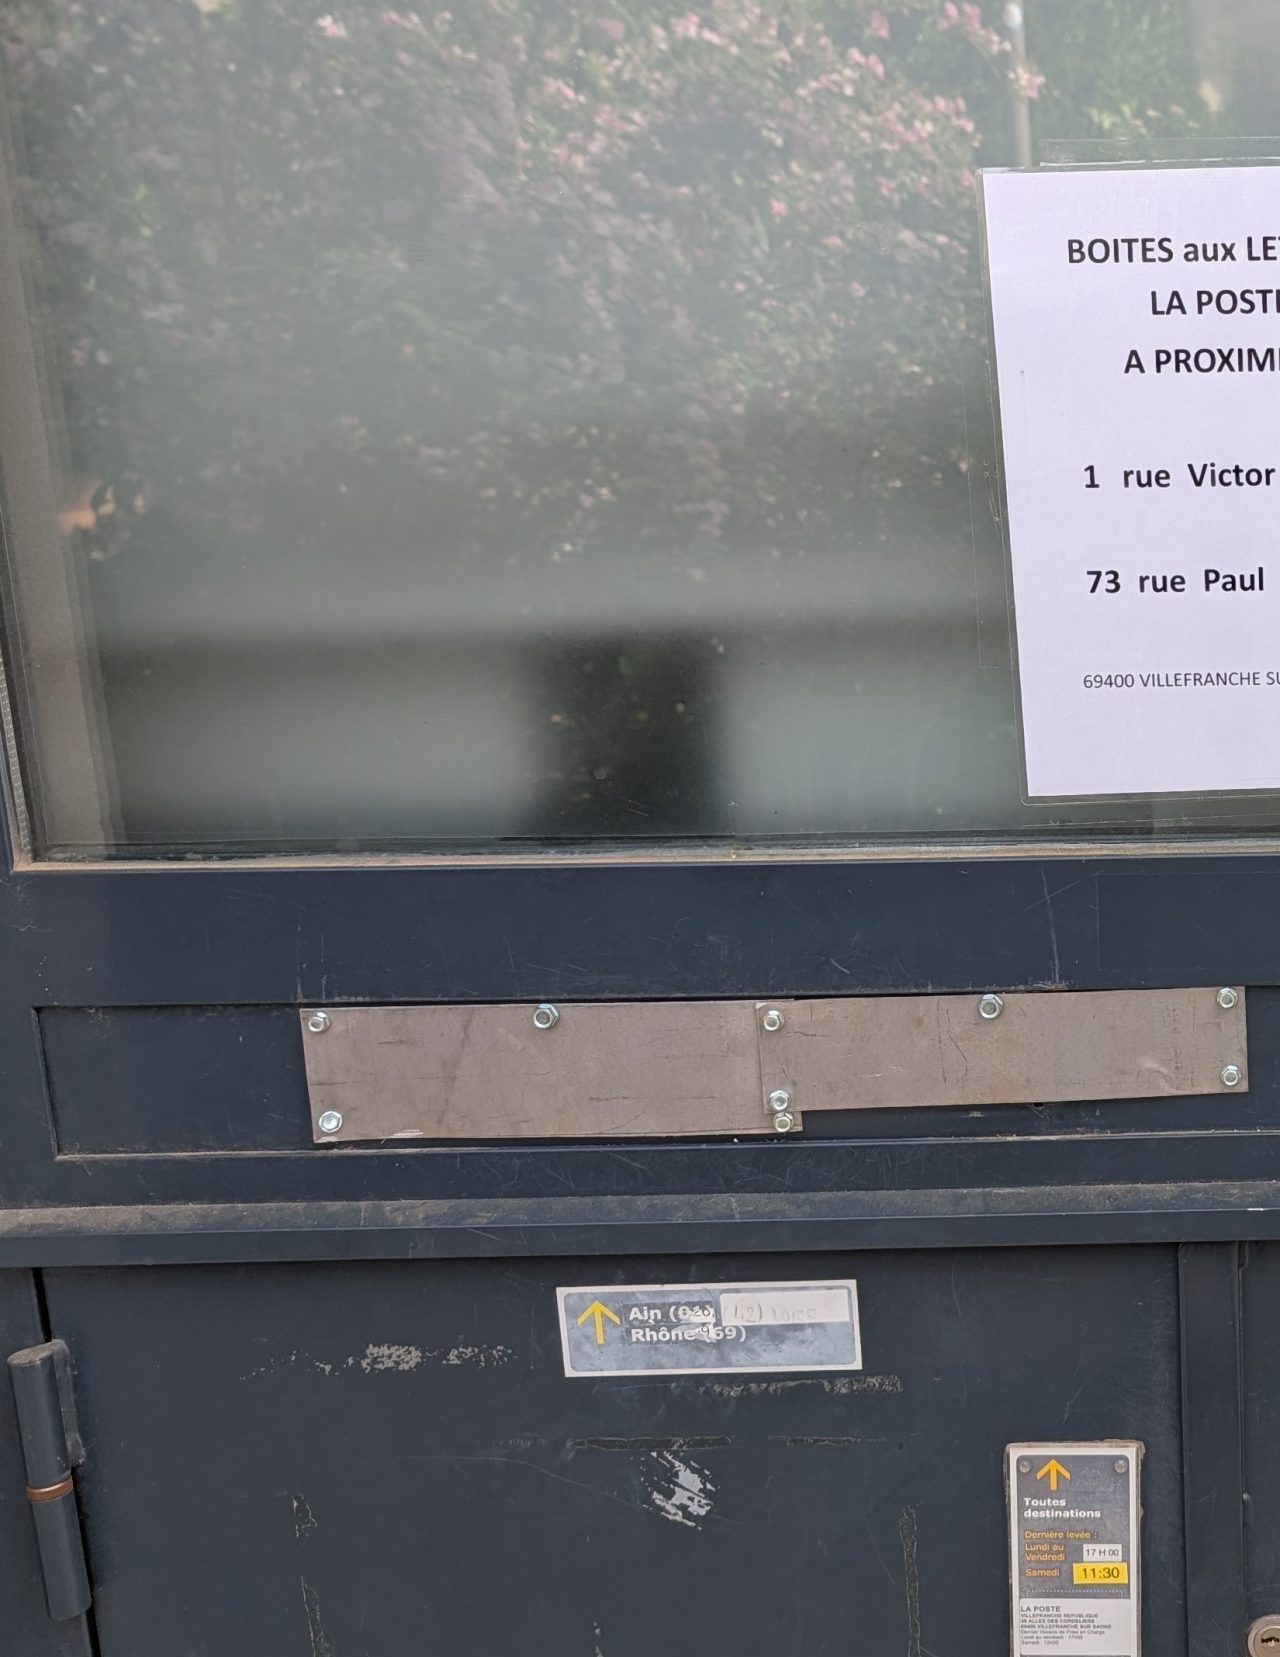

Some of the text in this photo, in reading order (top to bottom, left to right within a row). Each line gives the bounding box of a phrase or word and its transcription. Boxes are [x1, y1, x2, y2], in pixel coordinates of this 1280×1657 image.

[1067, 237, 1174, 264] BOITES
[1183, 240, 1237, 263] aux
[1151, 289, 1187, 315] LA
[1124, 349, 1145, 374] A
[1084, 465, 1100, 489] 1
[1123, 467, 1171, 488] rue
[1187, 461, 1276, 488] Victor
[1086, 570, 1121, 595] 73
[1139, 573, 1186, 593] rue
[1204, 568, 1264, 593] Paul
[1083, 672, 1135, 689] 69400
[1140, 670, 1261, 688] VILLEFRANCHE
[628, 1306, 662, 1322] Ain
[631, 1324, 696, 1342] Rhône
[1024, 1498, 1066, 1506] Toutes
[1024, 1509, 1101, 1518] destinations
[1024, 1531, 1064, 1539] Dernière
[1066, 1531, 1091, 1539] levée
[1025, 1543, 1049, 1551] Lundi
[1024, 1553, 1065, 1561] Vendredi
[1025, 1569, 1060, 1577] Samedi
[1082, 1567, 1120, 1579] 11:30
